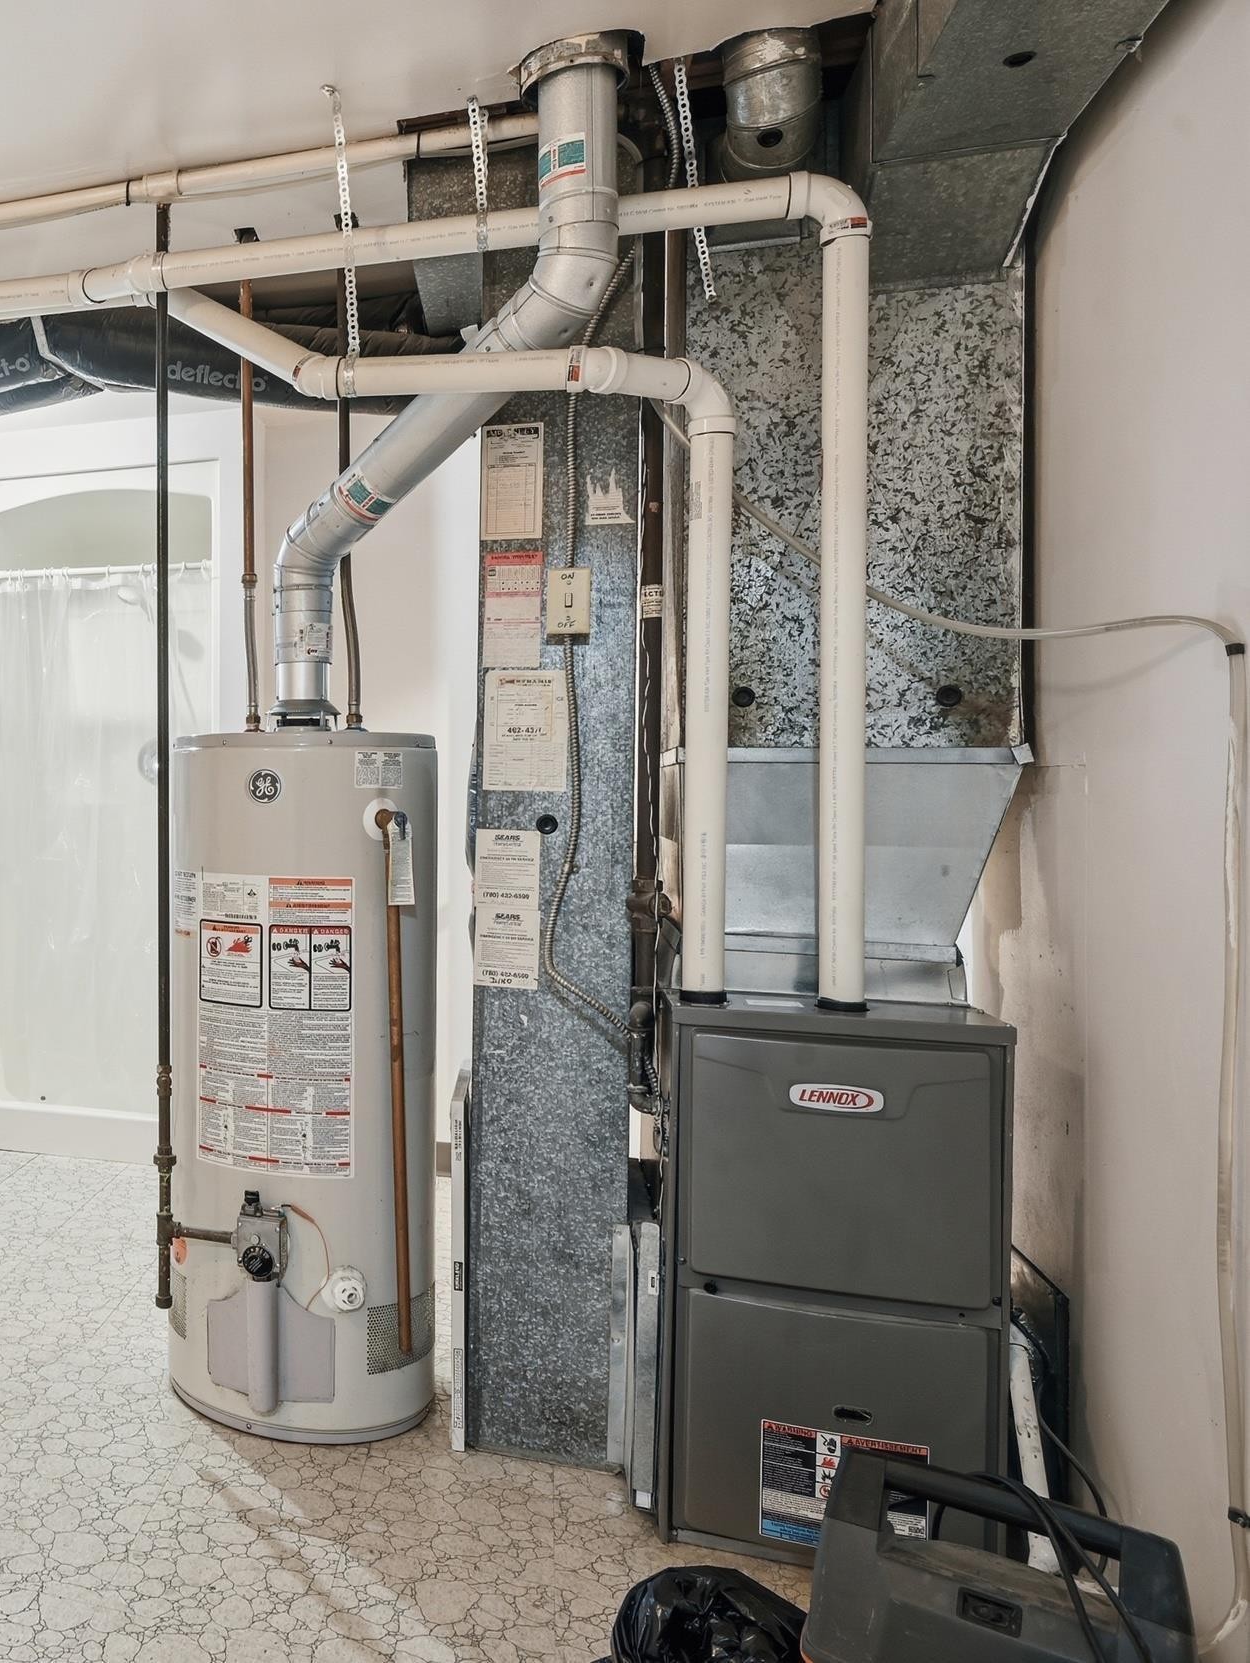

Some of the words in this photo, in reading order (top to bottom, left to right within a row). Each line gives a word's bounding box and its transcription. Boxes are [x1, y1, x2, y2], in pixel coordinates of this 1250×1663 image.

[561, 572, 575, 580] ON
[558, 620, 576, 628] OFF
[494, 912, 521, 921] SEARS
[799, 1089, 860, 1106] LENNOX
